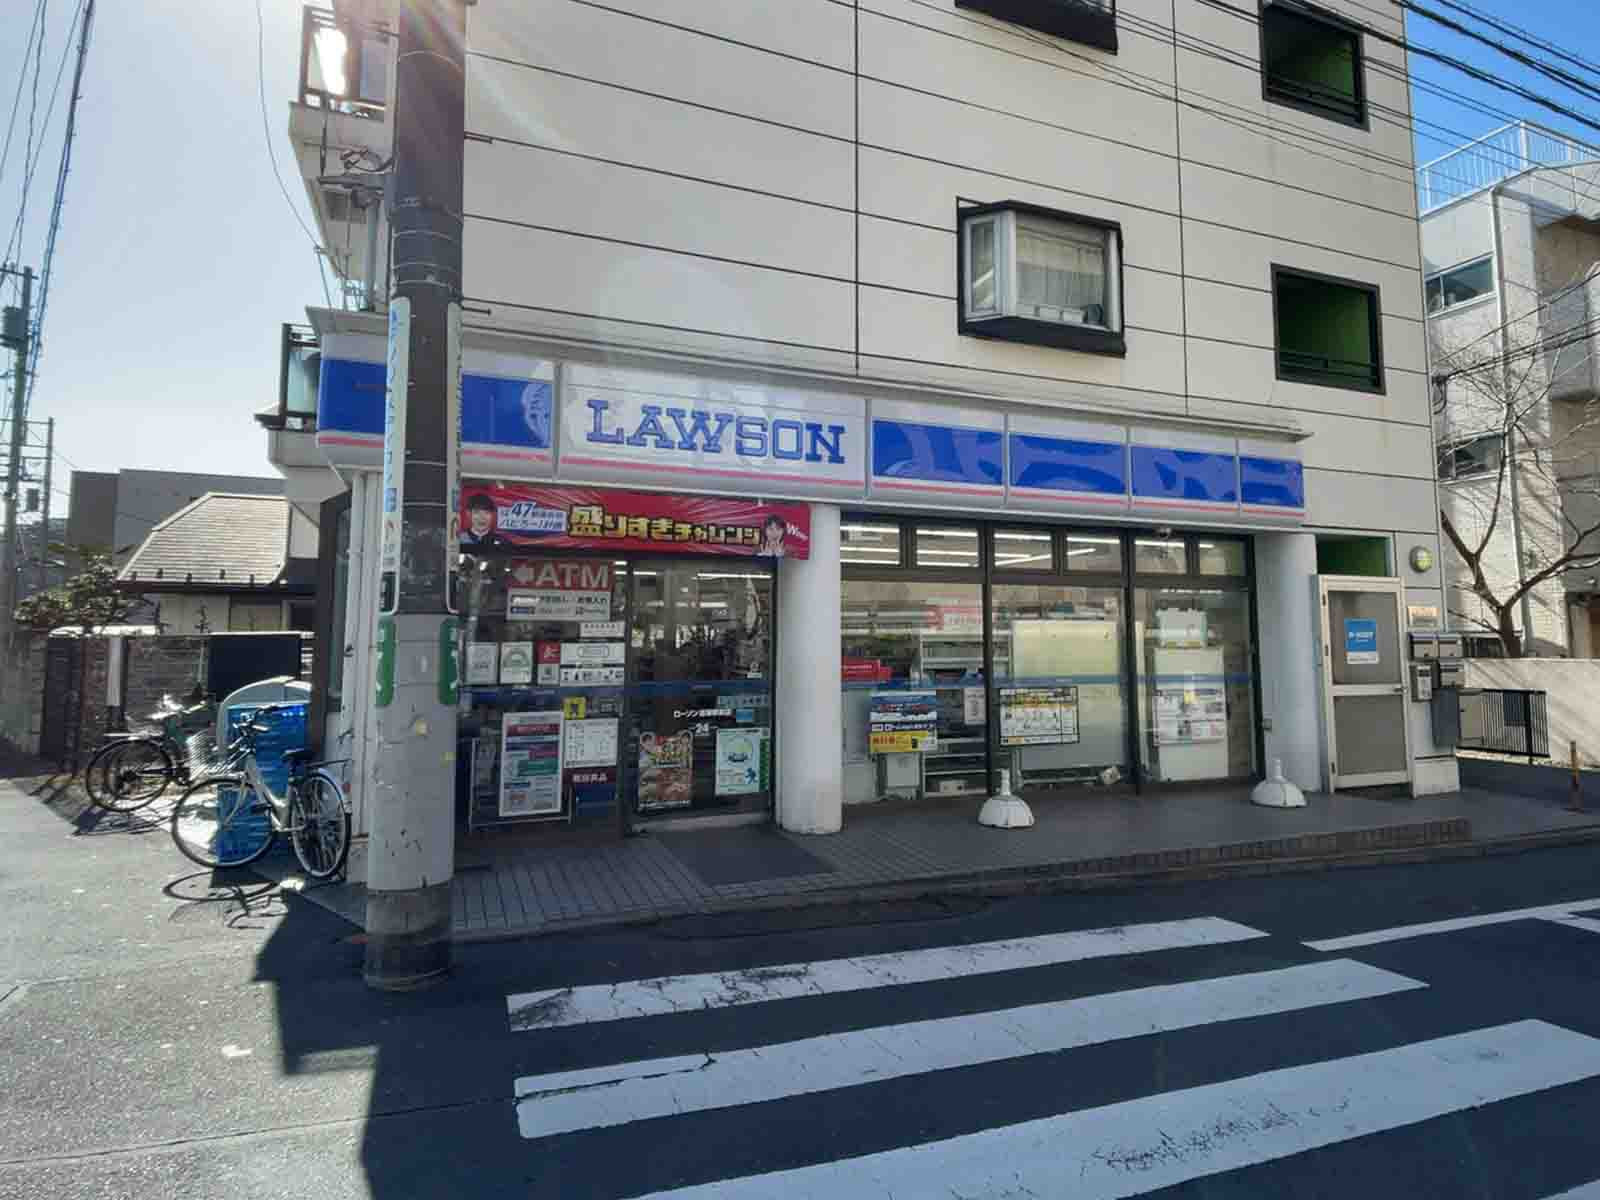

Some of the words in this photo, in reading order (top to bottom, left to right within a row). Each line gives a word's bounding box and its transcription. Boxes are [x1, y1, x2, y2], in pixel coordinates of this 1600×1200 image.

[586, 399, 845, 464] LAWSON
[569, 504, 760, 545] 盛りすぎチャレンジ
[535, 560, 609, 588] ATM
